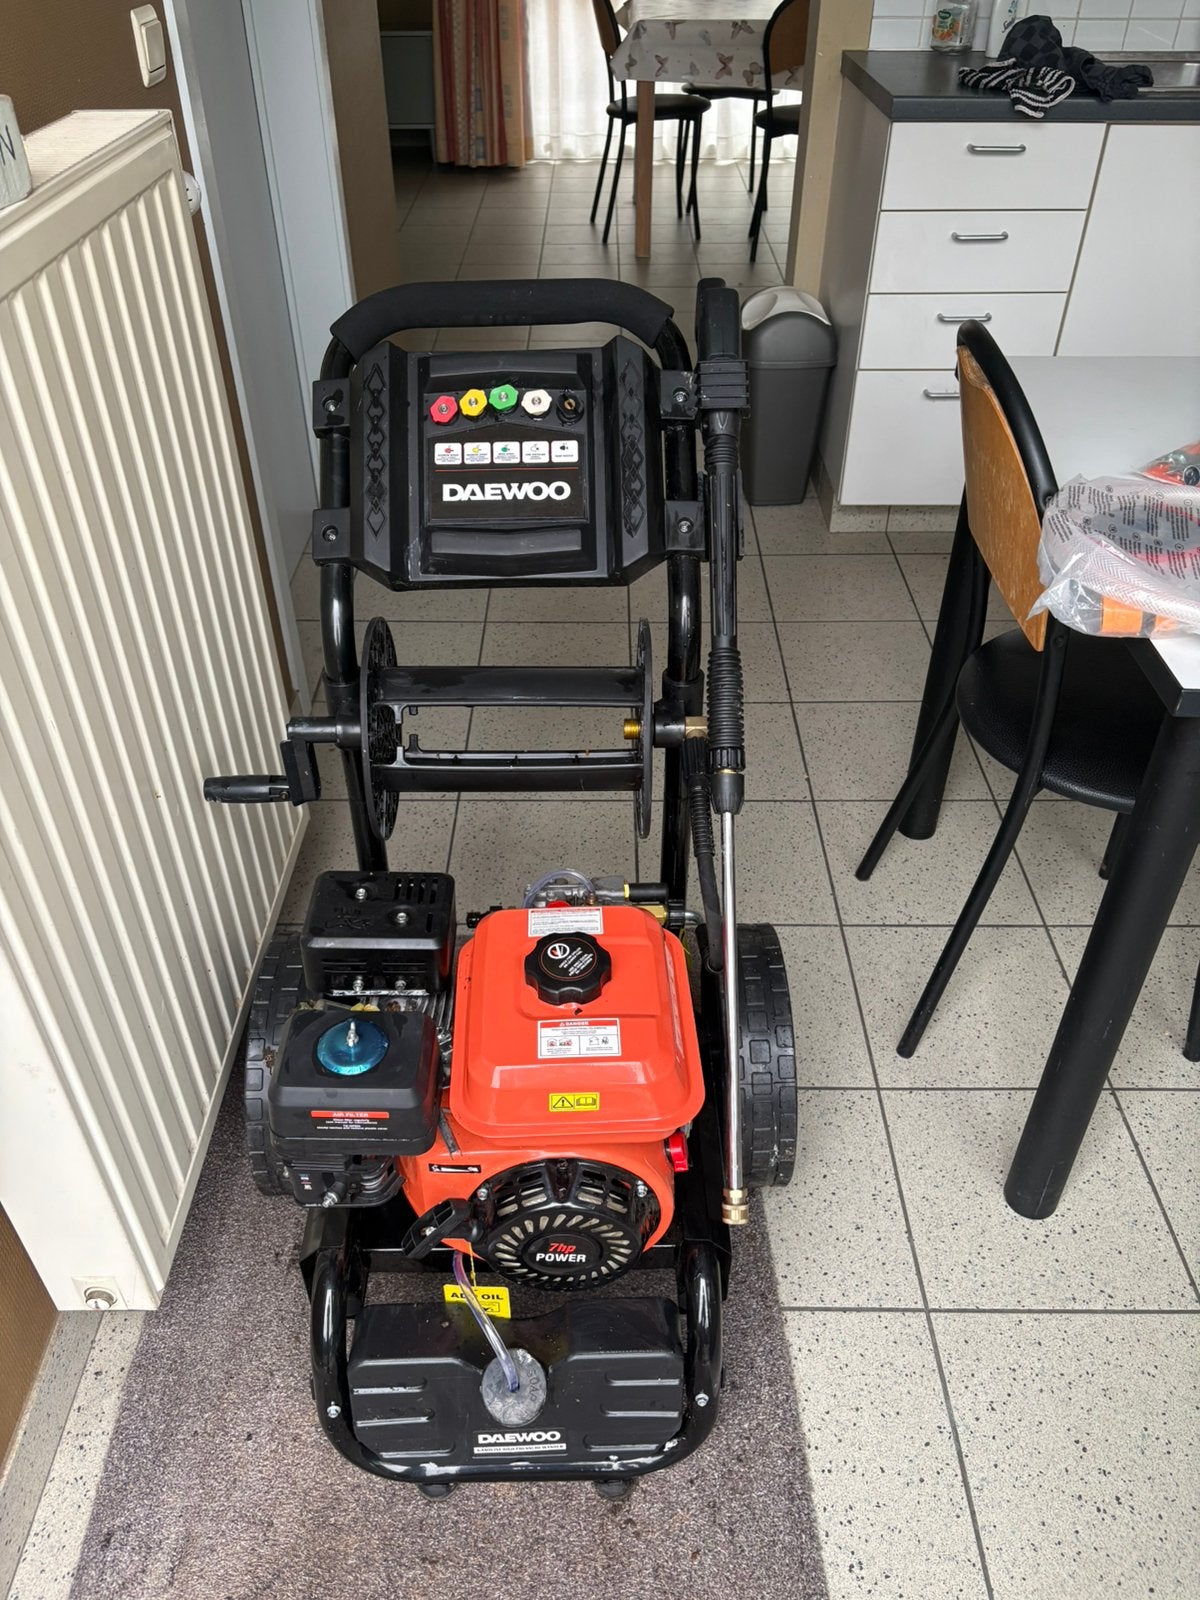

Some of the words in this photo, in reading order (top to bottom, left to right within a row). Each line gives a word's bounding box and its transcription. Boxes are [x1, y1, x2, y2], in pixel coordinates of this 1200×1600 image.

[442, 481, 571, 502] DAEWOO
[549, 1242, 577, 1254] 7hp
[535, 1253, 587, 1263] POWER
[477, 1430, 561, 1444] DAEWOO
